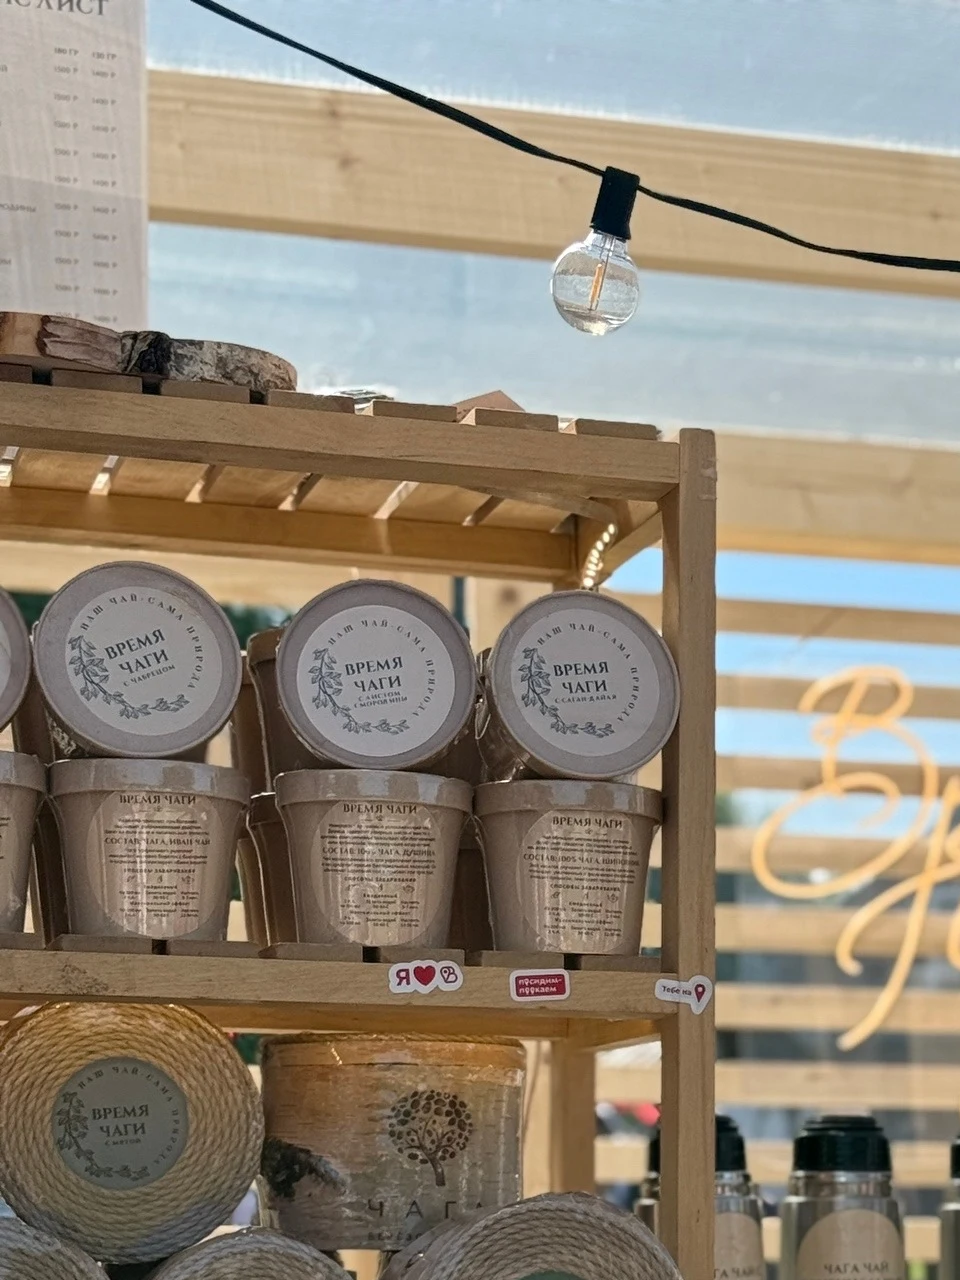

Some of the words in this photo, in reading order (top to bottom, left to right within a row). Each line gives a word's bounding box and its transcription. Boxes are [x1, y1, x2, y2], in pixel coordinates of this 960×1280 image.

[104, 629, 166, 660] ВРЕМЯ
[118, 649, 169, 674] ЧАГИ
[344, 656, 404, 676] ВРЕМЯ
[552, 661, 609, 677] ВРЕМЯ
[130, 664, 176, 684] ЧАБРЕЦОМ
[354, 675, 402, 692] ЧАГИ
[562, 679, 608, 694] ЧАГИ
[119, 794, 162, 805] ВРЕМЯ
[164, 794, 197, 806] ЧАГИ
[343, 803, 383, 814] ВРЕМЯ
[387, 804, 417, 815] ЧАГИ
[552, 816, 592, 827] ВРЕМЯ
[595, 818, 623, 829] ЧАГИ
[395, 968, 411, 987] Я
[91, 1104, 150, 1121] ВРЕМЯ
[99, 1122, 147, 1137] ЧАГИ
[824, 1263, 859, 1275] ЧАГА
[863, 1260, 889, 1274] ЧАЙ
